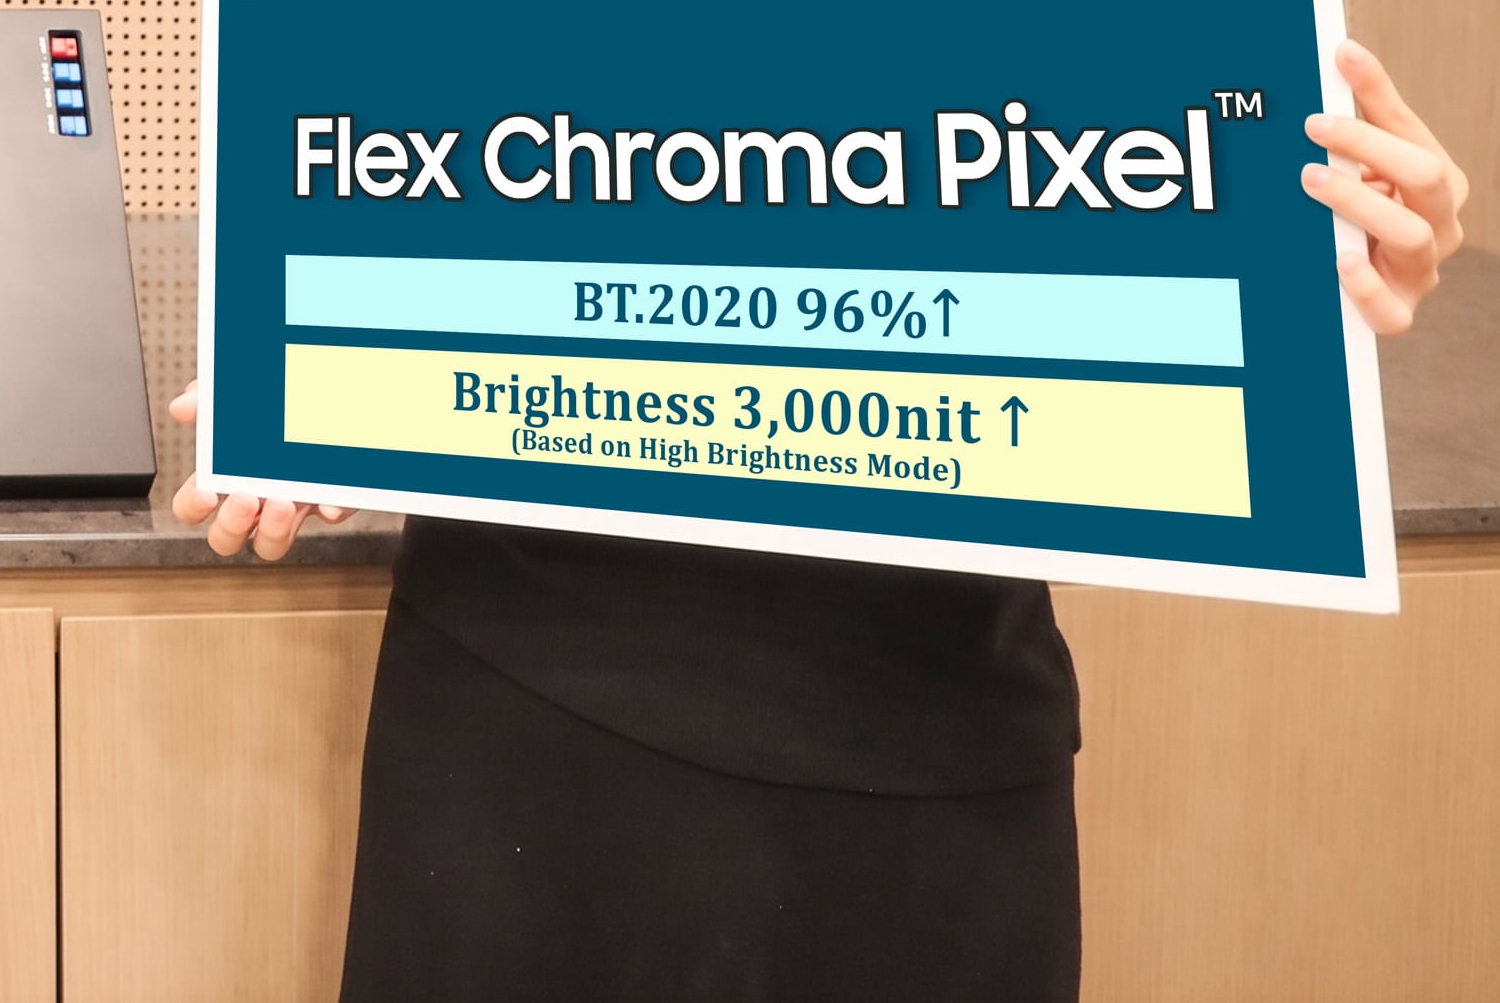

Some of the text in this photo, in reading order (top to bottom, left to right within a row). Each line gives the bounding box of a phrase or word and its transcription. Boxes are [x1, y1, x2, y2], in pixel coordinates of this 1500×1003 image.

[294, 114, 462, 200] Flex
[482, 113, 907, 207] Chroma
[573, 281, 927, 339] BT.2020 96%
[453, 371, 981, 444] Brightness 3,000nit
[512, 427, 961, 490] (Based on High Brightness Mode)
